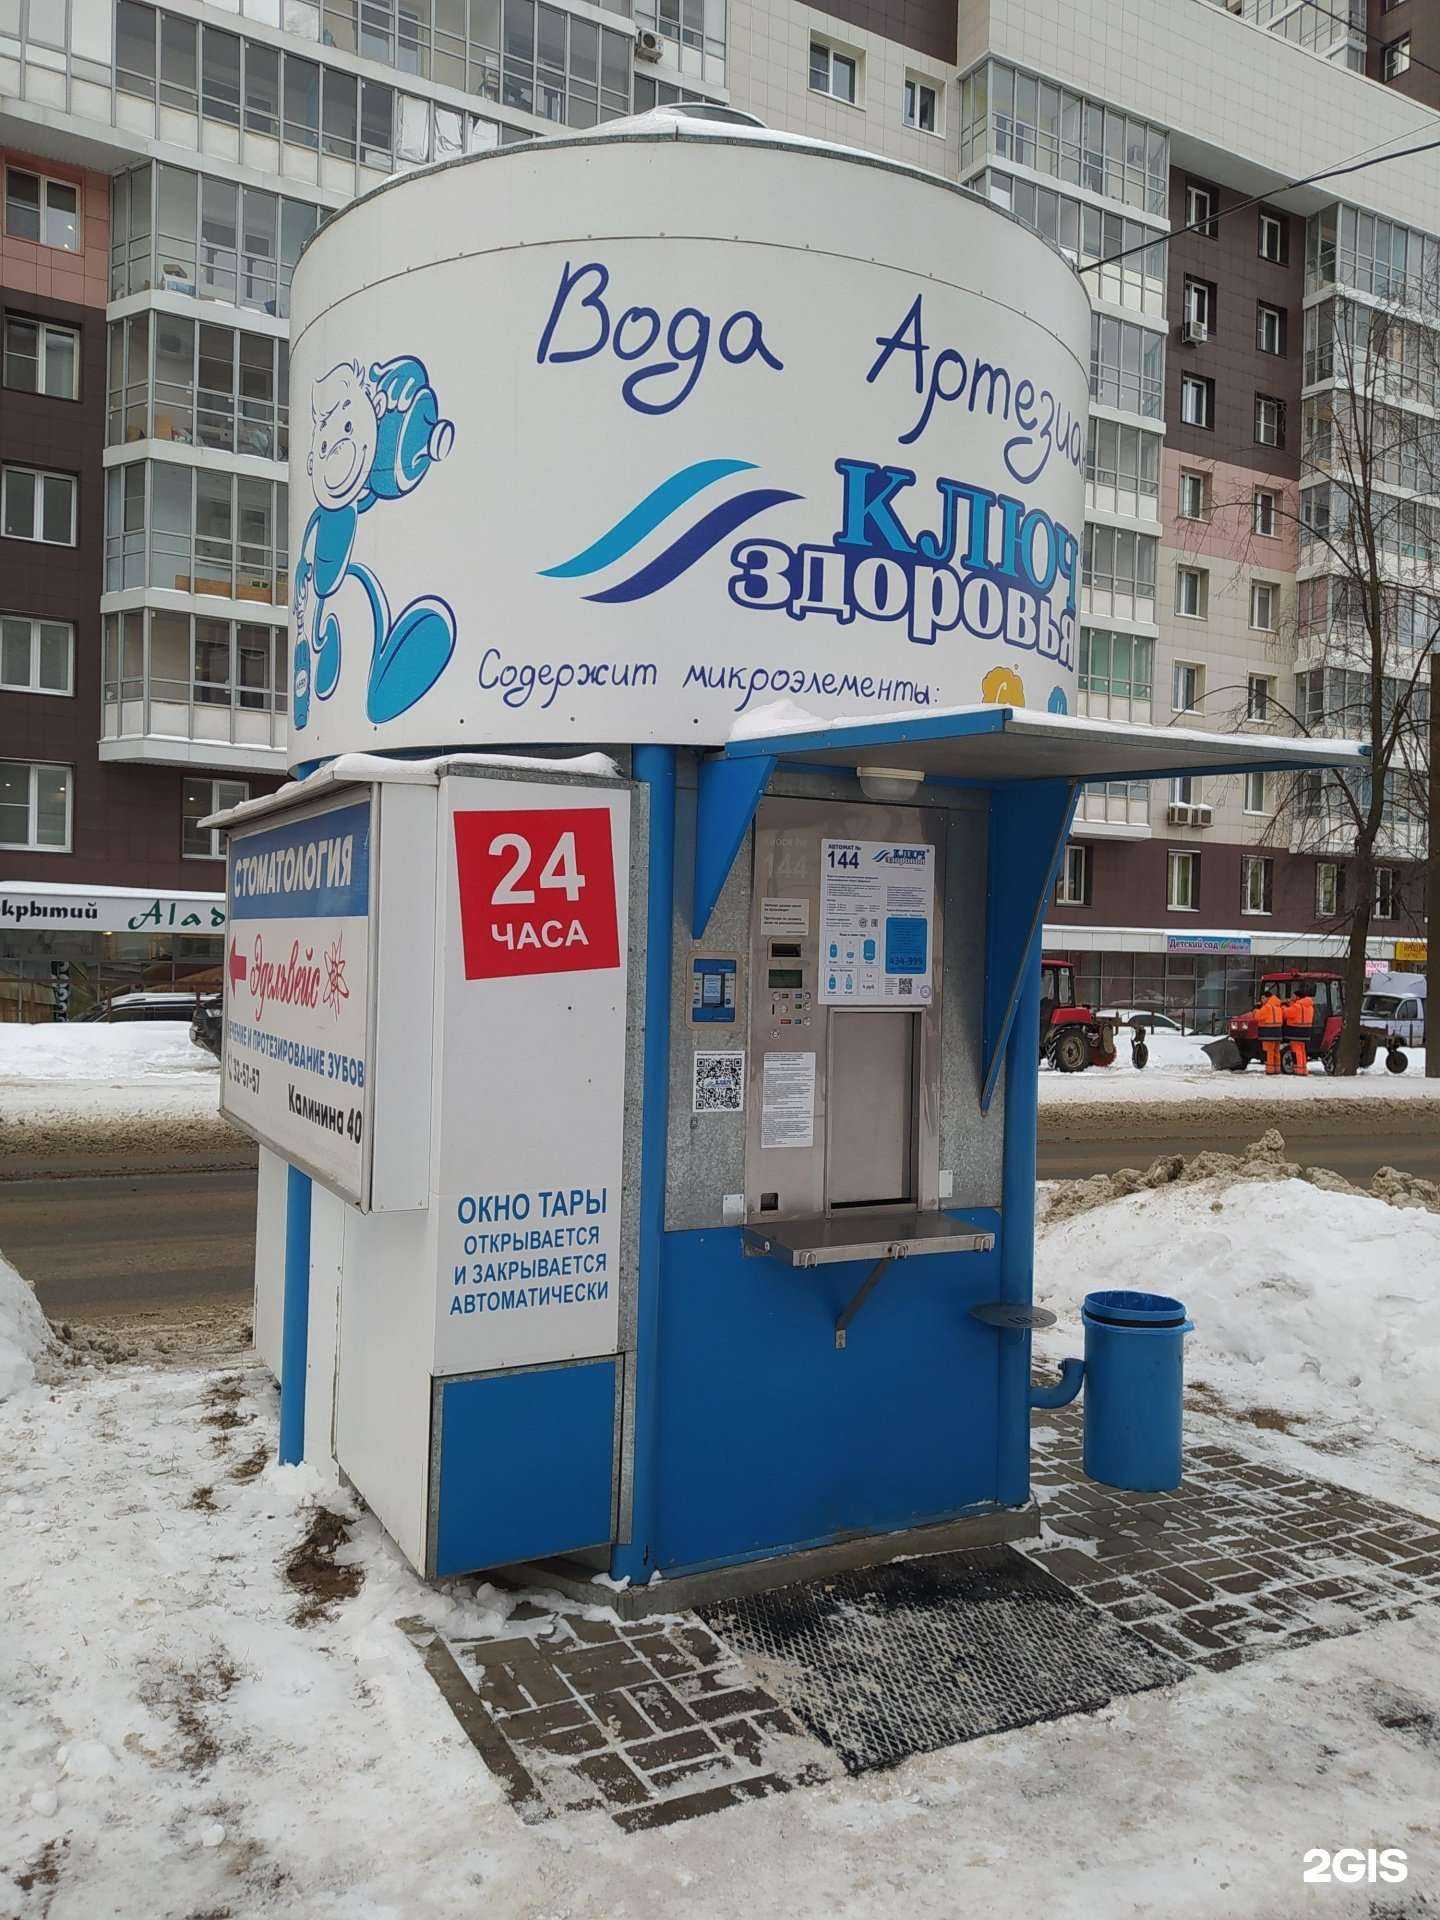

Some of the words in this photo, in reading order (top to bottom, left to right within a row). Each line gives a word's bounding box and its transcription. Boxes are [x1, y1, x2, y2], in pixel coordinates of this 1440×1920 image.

[537, 261, 783, 415] Вода
[866, 294, 1086, 484] Артезиа
[833, 458, 1079, 612] КЛЮЧ
[478, 647, 658, 709] Содержит
[682, 661, 942, 712] микроэлементы:
[233, 834, 354, 898] СТОМАТОЛОГИЯ
[488, 831, 587, 906] 24
[827, 850, 860, 869] 144
[0, 898, 98, 923] крытий
[490, 919, 590, 951] ЧАСА
[1168, 936, 1203, 951] Детский
[1205, 941, 1219, 952] сад
[249, 934, 321, 1022] Эдельвейс
[228, 1021, 247, 1047] ЕЧЕНИЕ
[253, 1030, 325, 1076] ПРОТЕЗИРОВАНИЕ
[328, 1052, 365, 1088] ЗУБОВ
[288, 1083, 344, 1136] Калинина
[346, 1107, 363, 1145] 40
[457, 1192, 530, 1225] ОКНО
[538, 1187, 608, 1219] ТАРЫ
[463, 1225, 600, 1256] ОТКРЫВАЕТСЯ
[454, 1265, 467, 1287] И
[472, 1252, 608, 1287] ЗАКРЫВАЕТСЯ
[449, 1281, 609, 1317] АВТОМАТИЧЕСКИ
